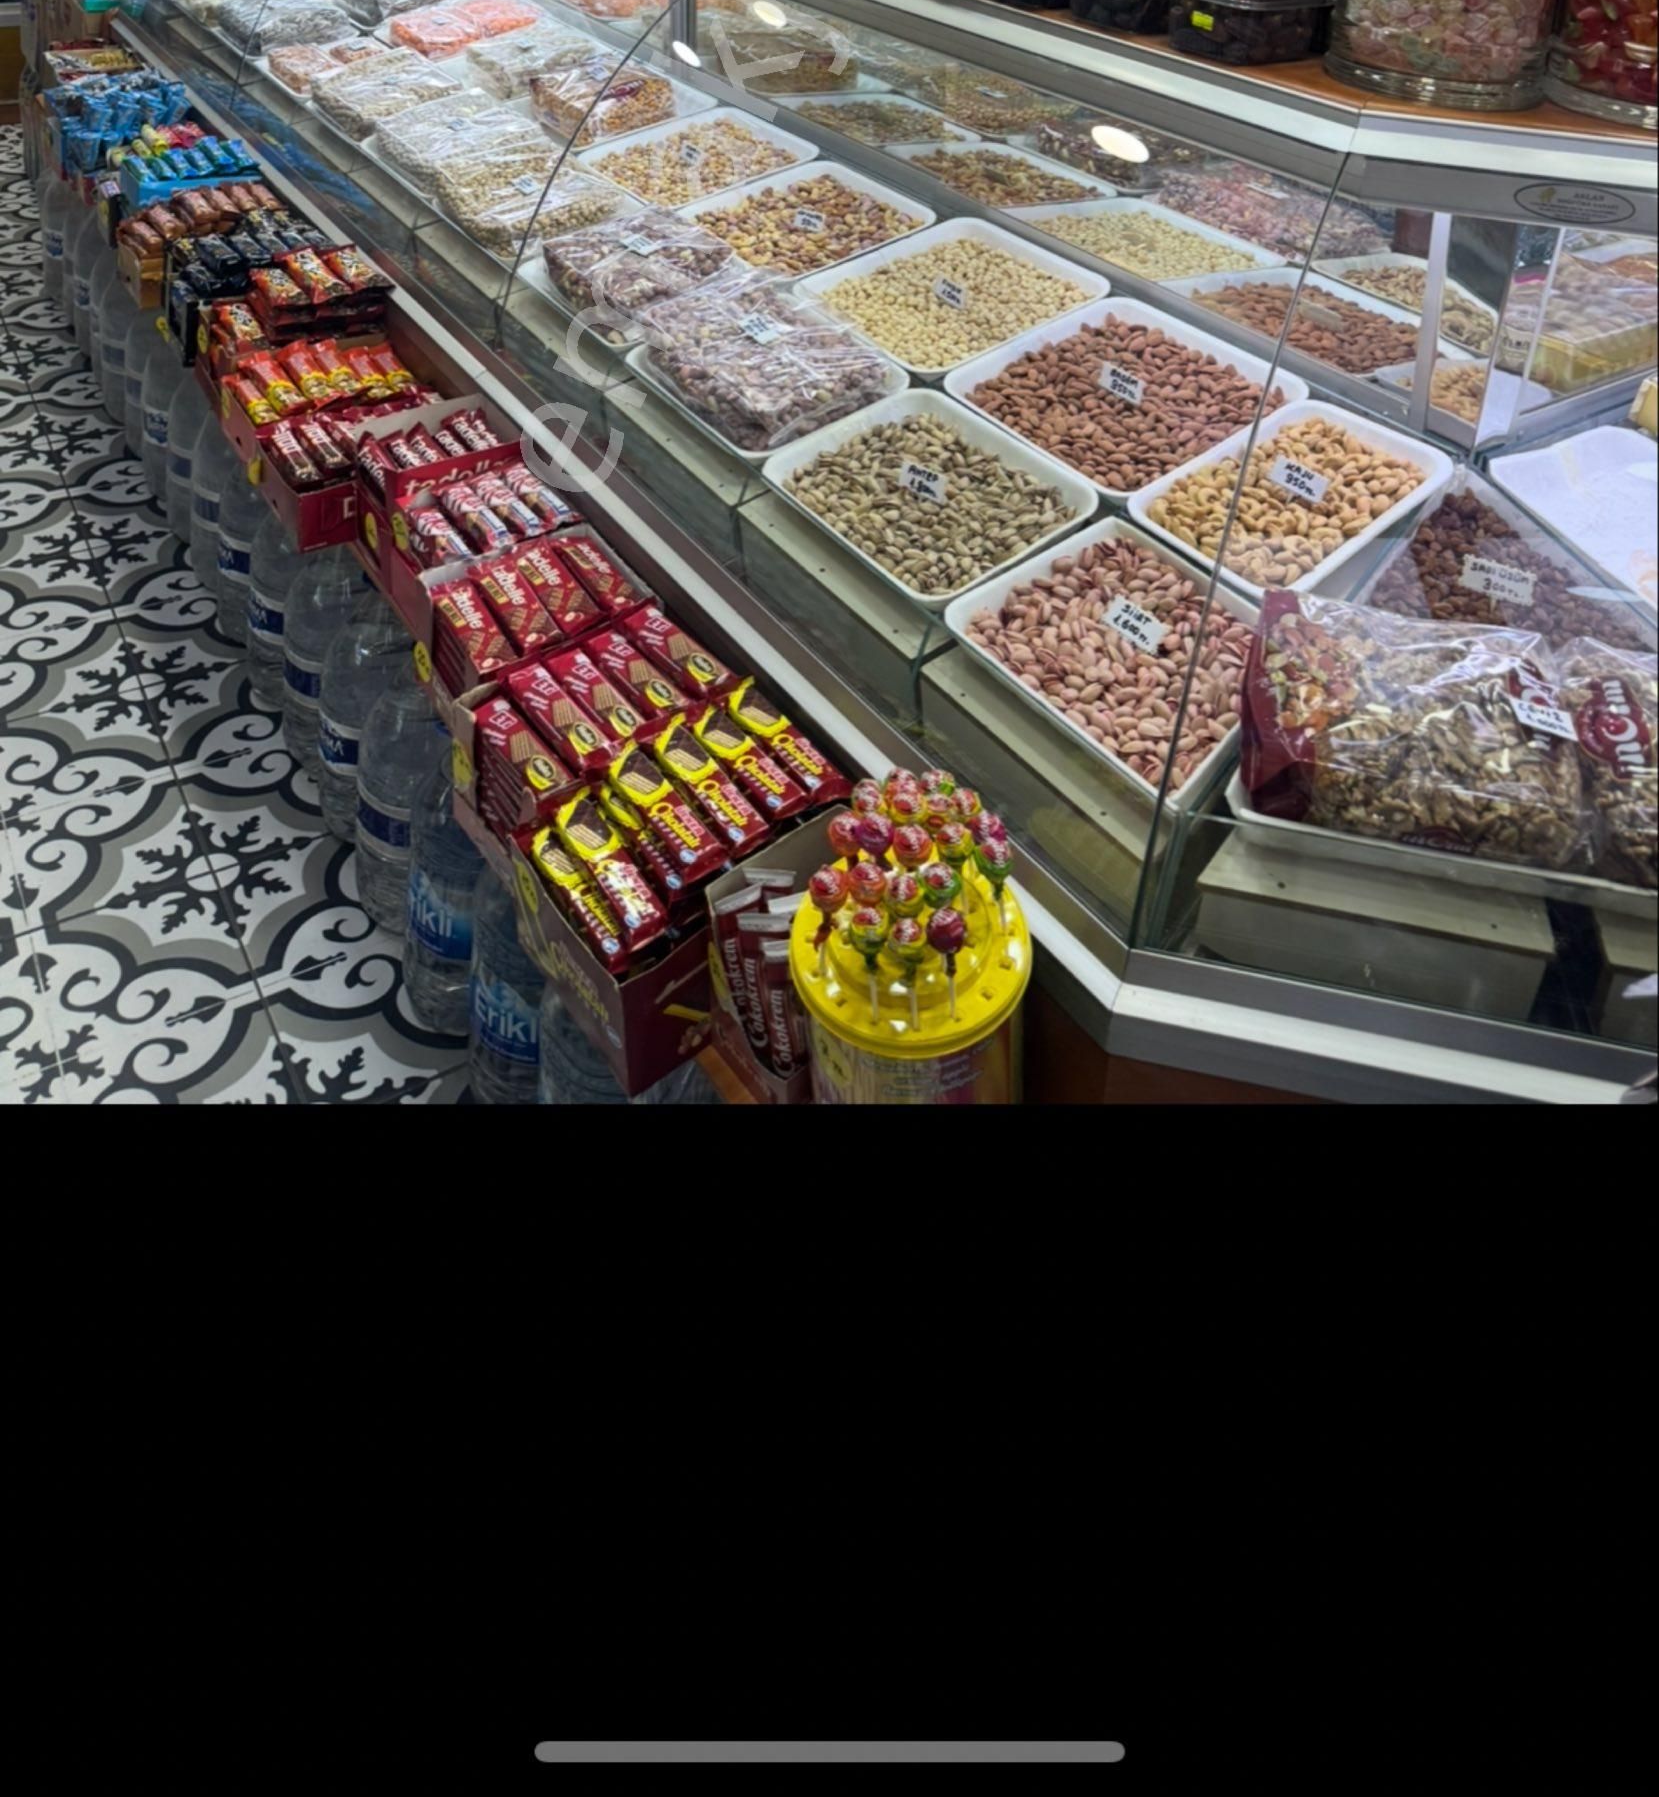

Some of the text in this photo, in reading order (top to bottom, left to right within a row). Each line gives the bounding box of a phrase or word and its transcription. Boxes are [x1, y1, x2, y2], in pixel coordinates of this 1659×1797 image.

[1285, 462, 1315, 481] KAJU
[413, 899, 453, 938] ikli
[475, 997, 536, 1044] Erikl
